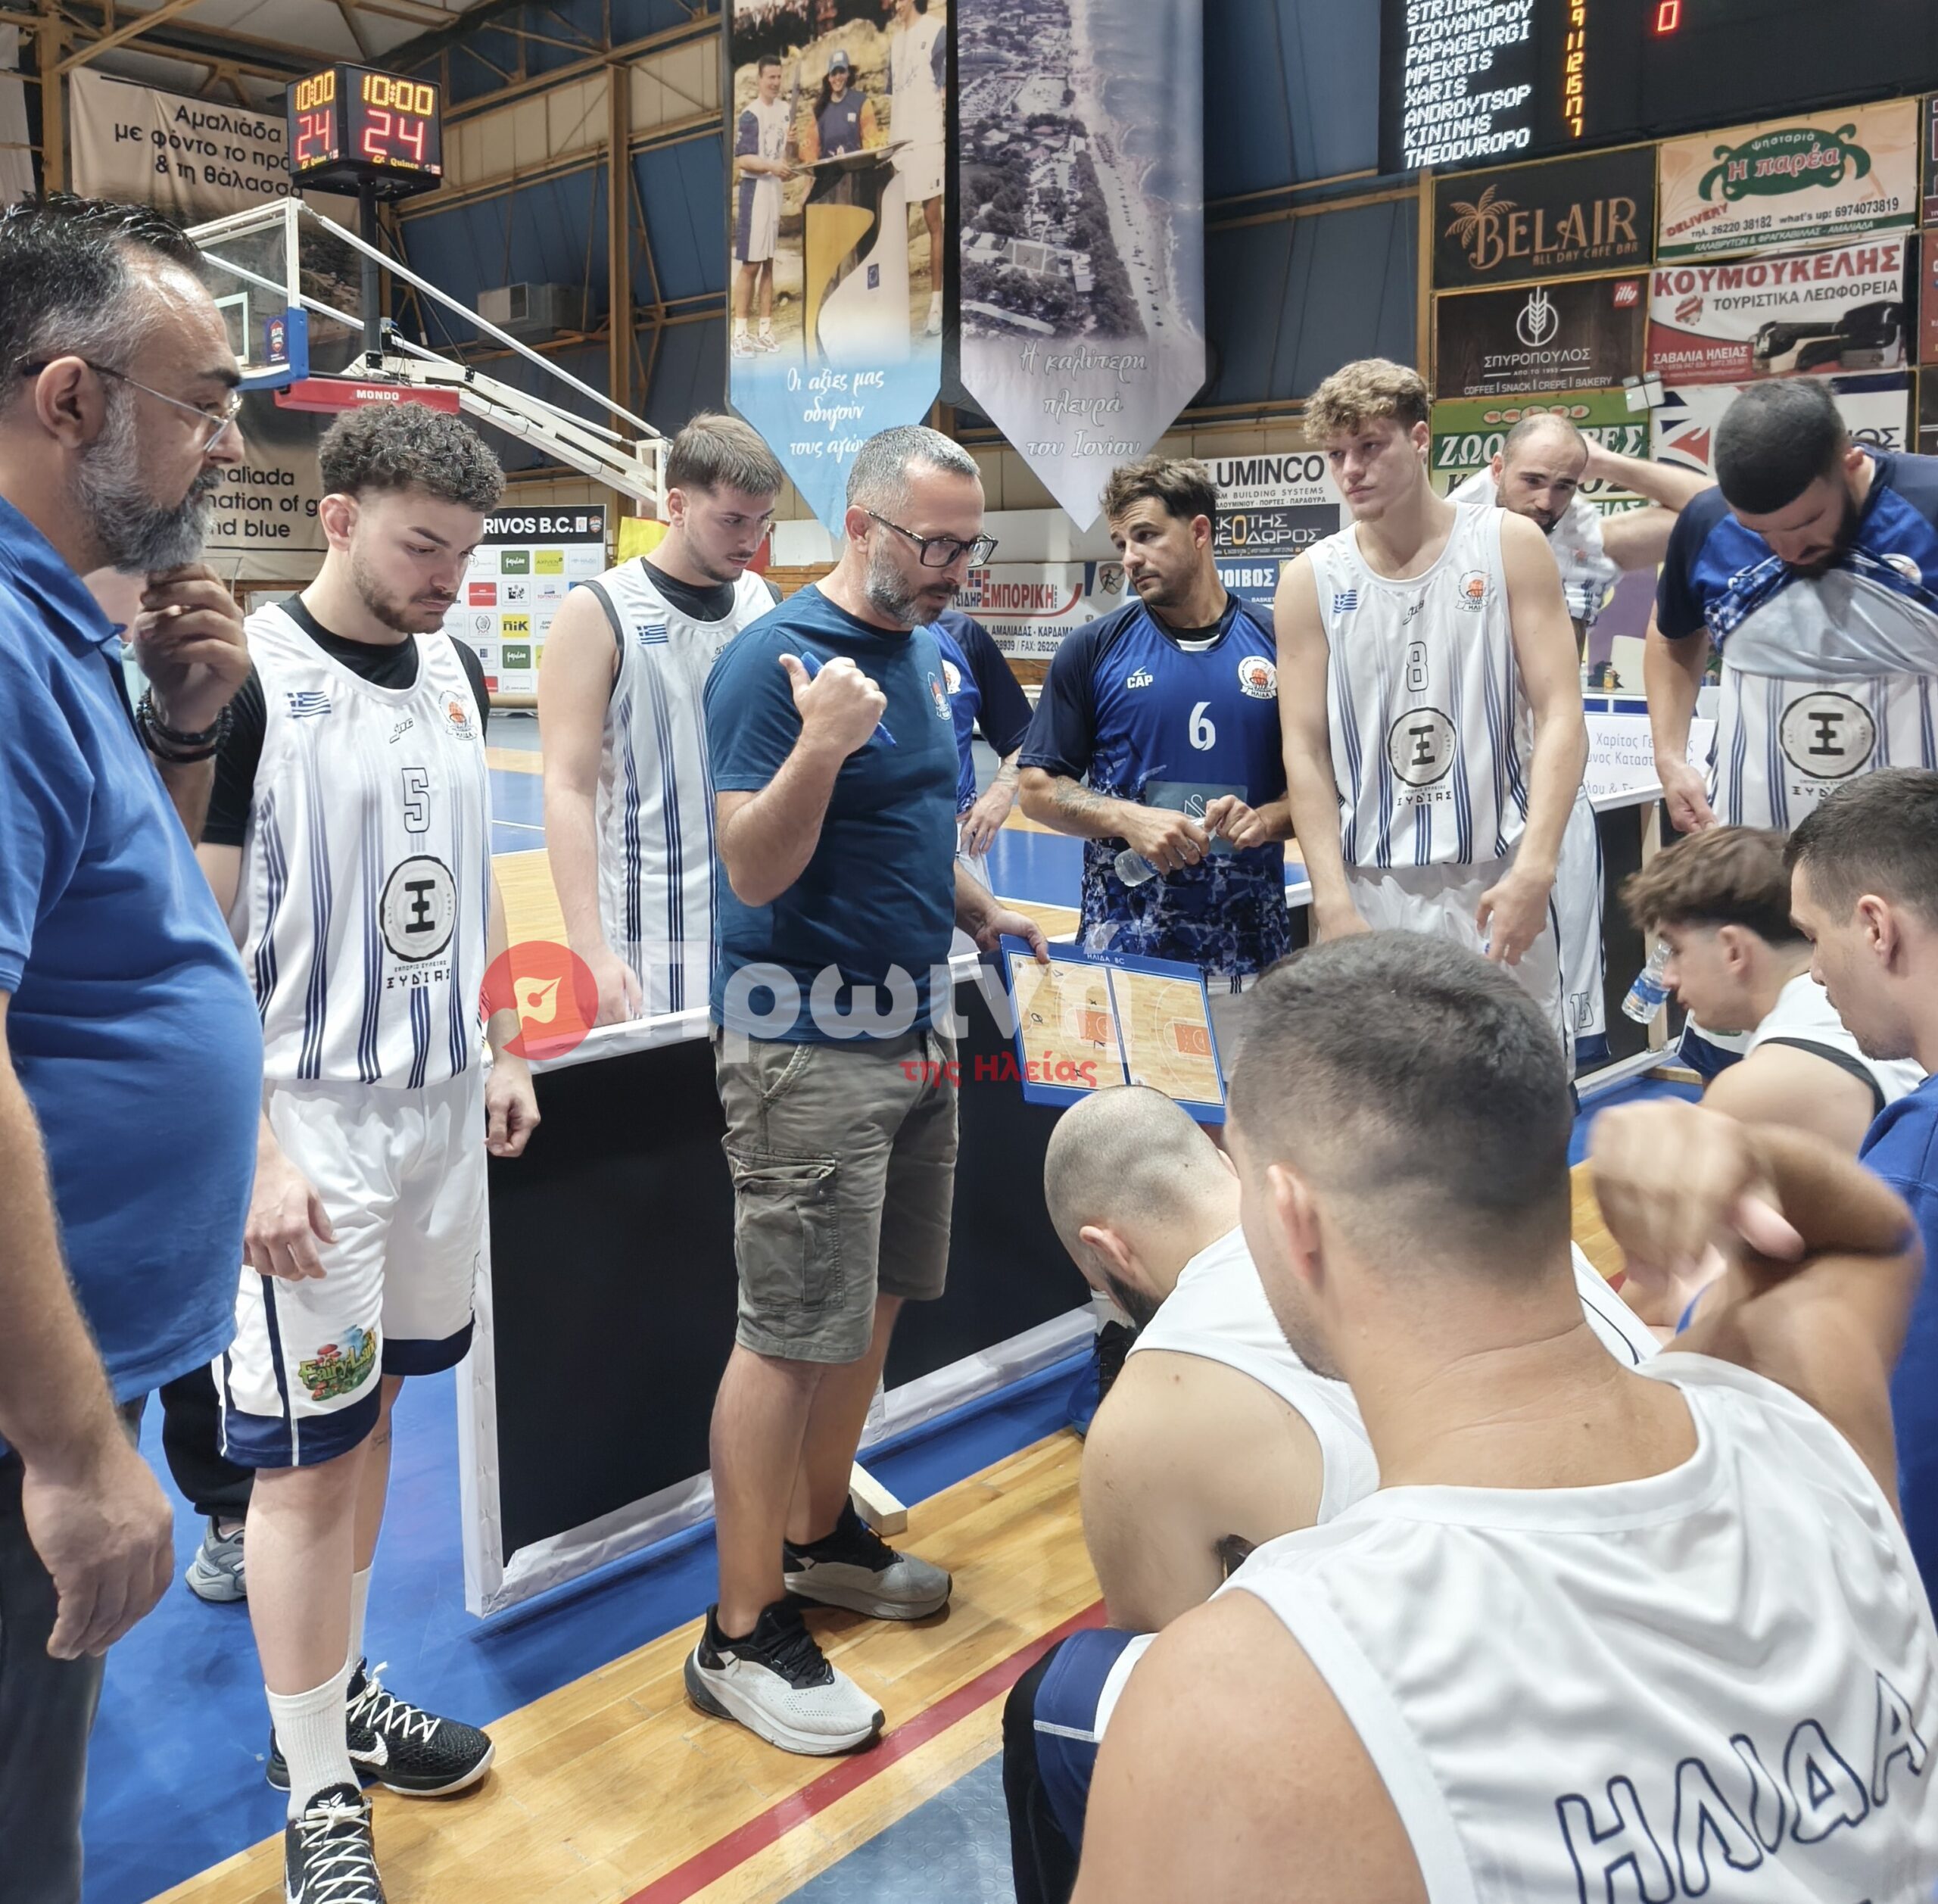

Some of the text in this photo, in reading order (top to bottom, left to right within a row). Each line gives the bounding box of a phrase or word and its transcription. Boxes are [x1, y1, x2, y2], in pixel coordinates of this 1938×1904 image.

[1572, 7, 1584, 26] 9
[1405, 30, 1584, 87] MPEKRIS 11
[296, 70, 335, 111] 10:00
[363, 75, 434, 115] 10:00
[1404, 52, 1584, 108] XARIS 12
[1404, 73, 1583, 129] ANDROYTSOP 15
[175, 104, 282, 143] Αμαλιάδα
[298, 110, 330, 160] 24
[363, 110, 423, 160] 24
[1404, 96, 1583, 149] KININHS 17
[1571, 118, 1583, 137] 7
[115, 123, 143, 142] με
[151, 130, 217, 156] φόντο
[224, 145, 246, 161] το
[1751, 132, 1816, 151] ψησταριά
[156, 155, 303, 198] & τη θάλασσα
[1728, 142, 1840, 182] Η παρέα
[1666, 203, 1728, 238] DELIVERY
[1712, 222, 1740, 235] 26220
[1743, 216, 1772, 230] 38182
[1779, 212, 1812, 223] what's
[1835, 198, 1899, 217] 6974073819
[1533, 254, 1550, 265] ALL
[1556, 251, 1579, 262] DAY
[1616, 242, 1638, 254] BAR
[1654, 245, 1900, 297] ΚΟΥΜΟΥΚΕΛΗΣ
[1616, 286, 1637, 304] illy
[1714, 280, 1898, 311] ΤΟΥΡΙΣΤΙΚΑ ΛΕΩΦΟΡΕΙΑ
[1020, 341, 1147, 384] Η καλύτερη
[1484, 348, 1591, 368] ΣΠΥΡΟΠΟΥΛΟΣ
[1653, 346, 1747, 363] ΣΑΒΑΛΙΑ ΗΛΕΙΑΣ
[357, 390, 399, 400] MONDO
[787, 367, 801, 391] Οι
[853, 370, 884, 397] μας
[1464, 376, 1612, 395] COFFEE SNACK CREPE BAKERY
[804, 397, 865, 432] οδηγούν
[1043, 389, 1123, 427] πλευρά
[790, 441, 821, 458] τους
[1027, 430, 1141, 459] του Ιονίου
[280, 495, 299, 512] of
[305, 499, 320, 517] g
[1233, 490, 1276, 499] BUILDING
[1282, 487, 1323, 497] SYSTEMS
[245, 519, 291, 538] blue
[540, 516, 573, 533] B.C.
[991, 625, 1032, 637] ΑΜΑΛΙΑΔΑΣ
[1022, 641, 1036, 652] FAX:
[1127, 675, 1153, 689] CAP
[1406, 641, 1429, 692] 8
[1189, 702, 1216, 751] 6
[1597, 732, 1637, 751] Χαρίτος
[401, 767, 430, 834] 5
[1086, 953, 1111, 963] ΗΛΙΔΑ
[1570, 992, 1594, 1033] 15
[1556, 1670, 1928, 1904] ΗΛΙΔΑ
